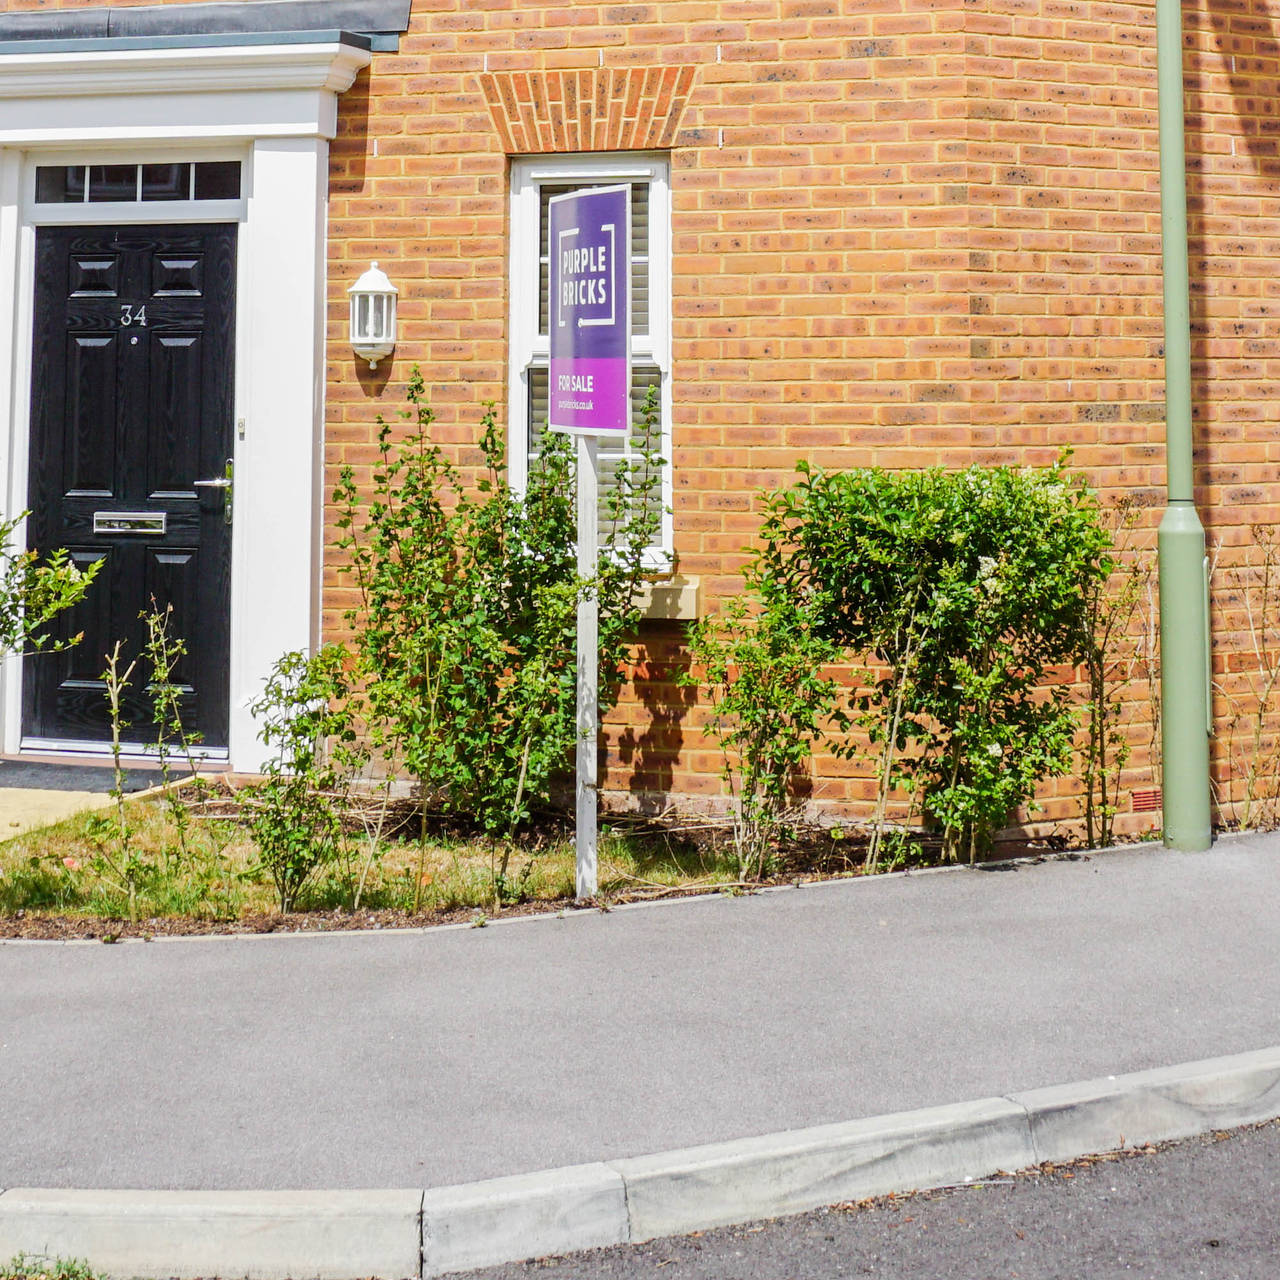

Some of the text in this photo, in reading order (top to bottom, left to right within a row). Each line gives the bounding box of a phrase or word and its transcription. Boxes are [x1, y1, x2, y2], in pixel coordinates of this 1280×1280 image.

[563, 246, 606, 274] PURPLE
[563, 278, 606, 306] BRICKS
[120, 304, 146, 326] 34
[558, 374, 594, 392] FOR SALE
